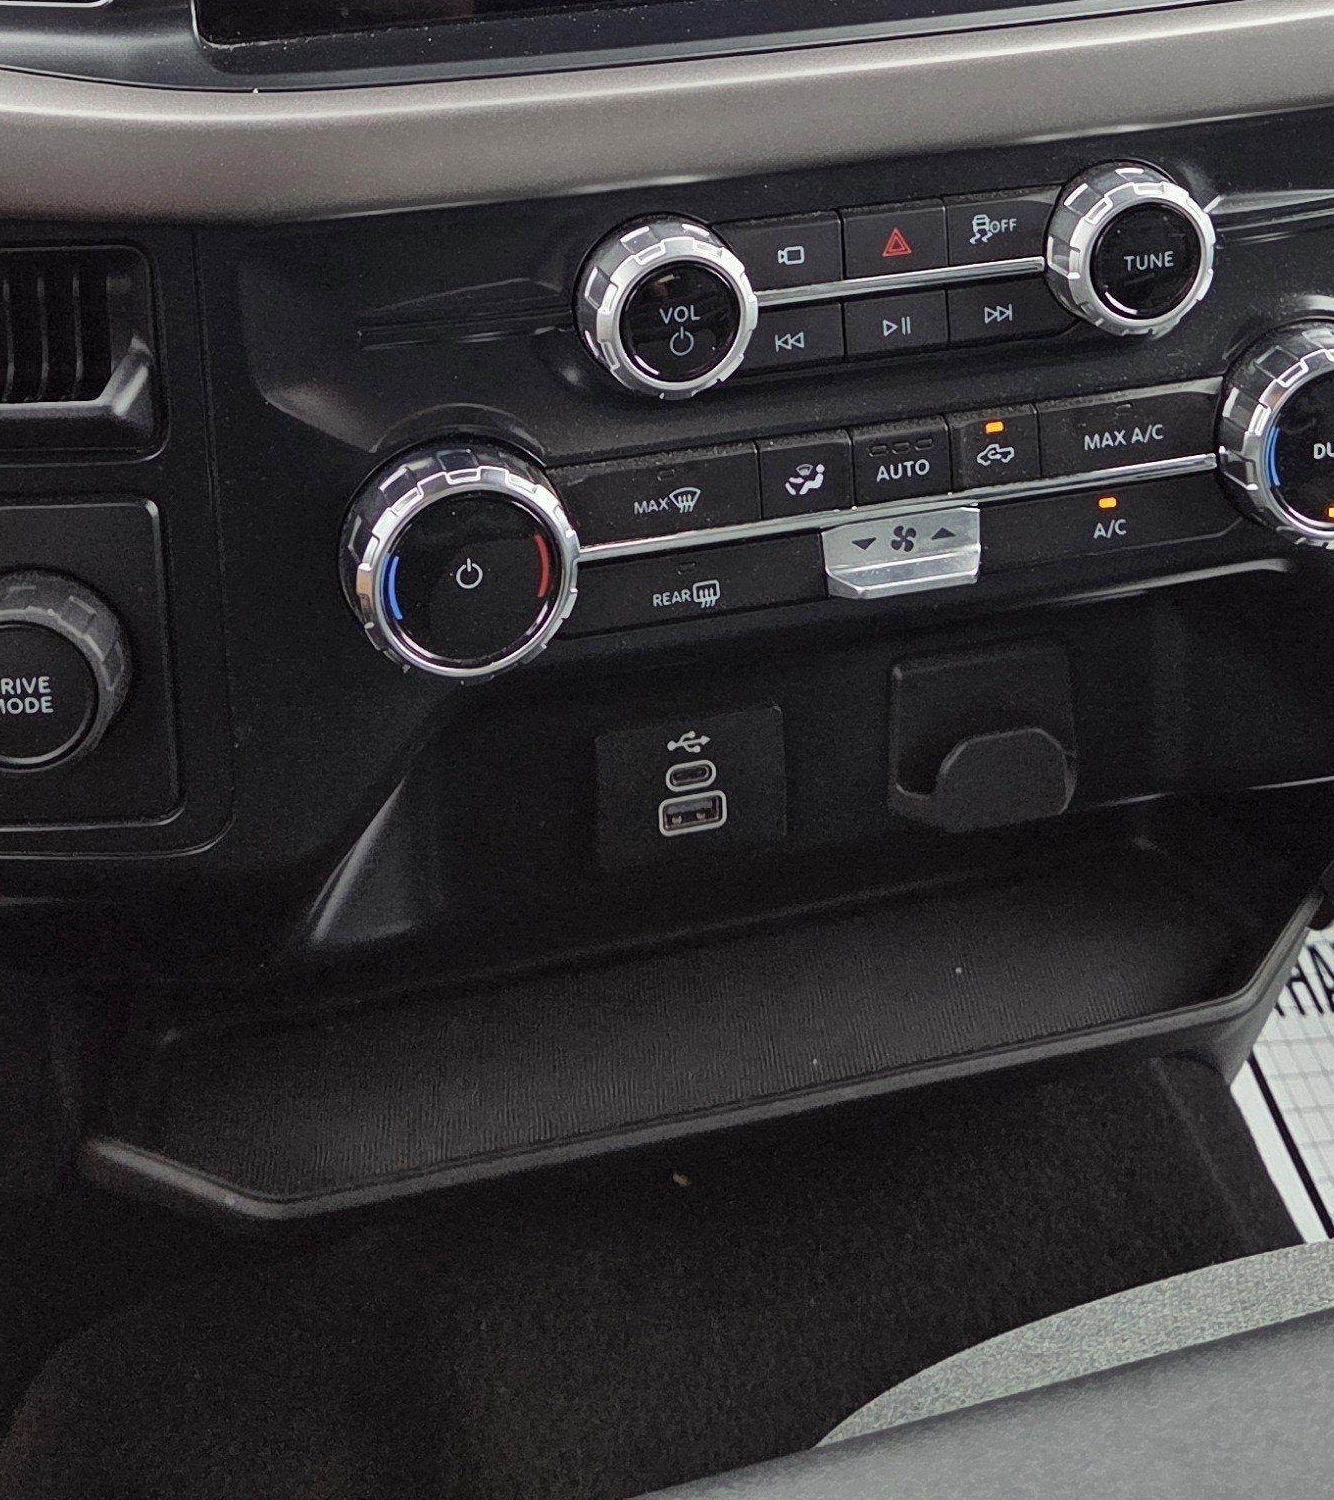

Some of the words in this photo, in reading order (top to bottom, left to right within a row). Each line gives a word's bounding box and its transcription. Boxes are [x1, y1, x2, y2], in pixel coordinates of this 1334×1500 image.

[988, 217, 1017, 233] OFF
[1123, 251, 1175, 271] TUNE
[659, 305, 701, 325] VOL
[1083, 430, 1127, 452] MAX
[1130, 424, 1165, 444] A/C
[875, 458, 931, 482] AUTO
[633, 496, 669, 515] MAX
[1093, 519, 1127, 539] A/C
[652, 588, 692, 607] REAR
